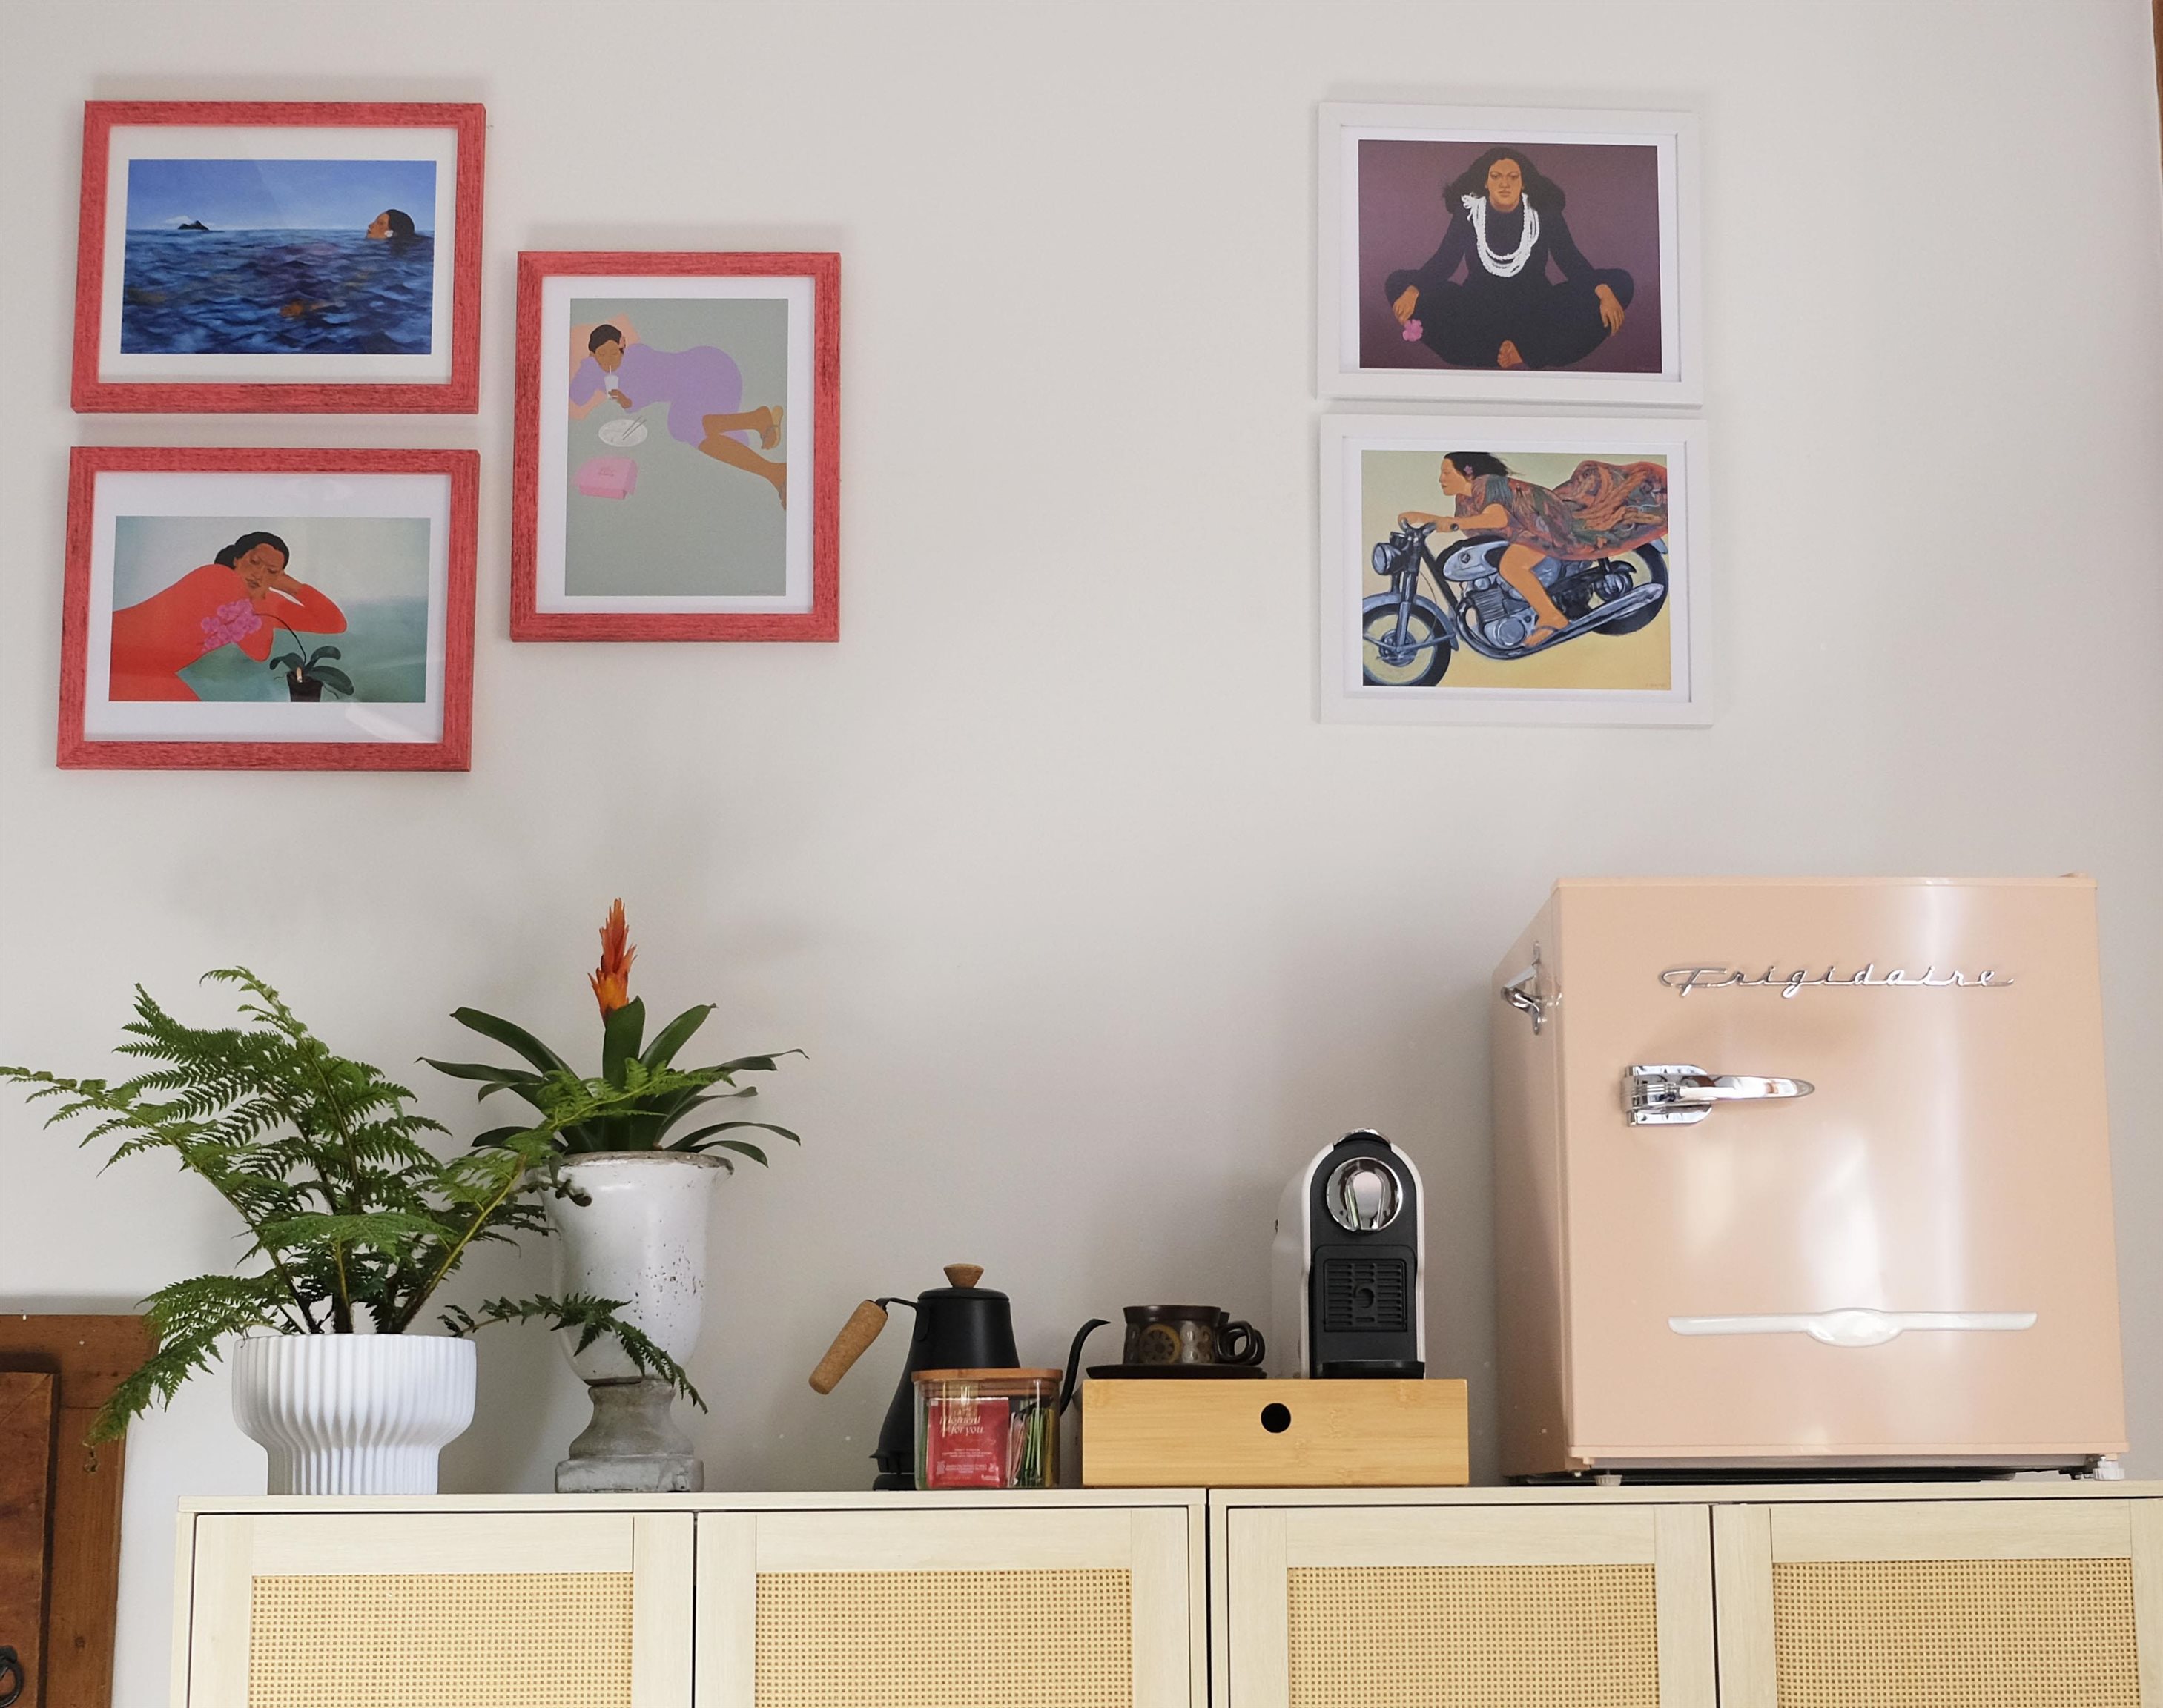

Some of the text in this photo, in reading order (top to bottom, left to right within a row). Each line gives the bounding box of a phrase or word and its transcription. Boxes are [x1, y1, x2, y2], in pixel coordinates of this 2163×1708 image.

[1658, 963, 2015, 998] Frigidaire
[950, 1423, 983, 1437] for you
